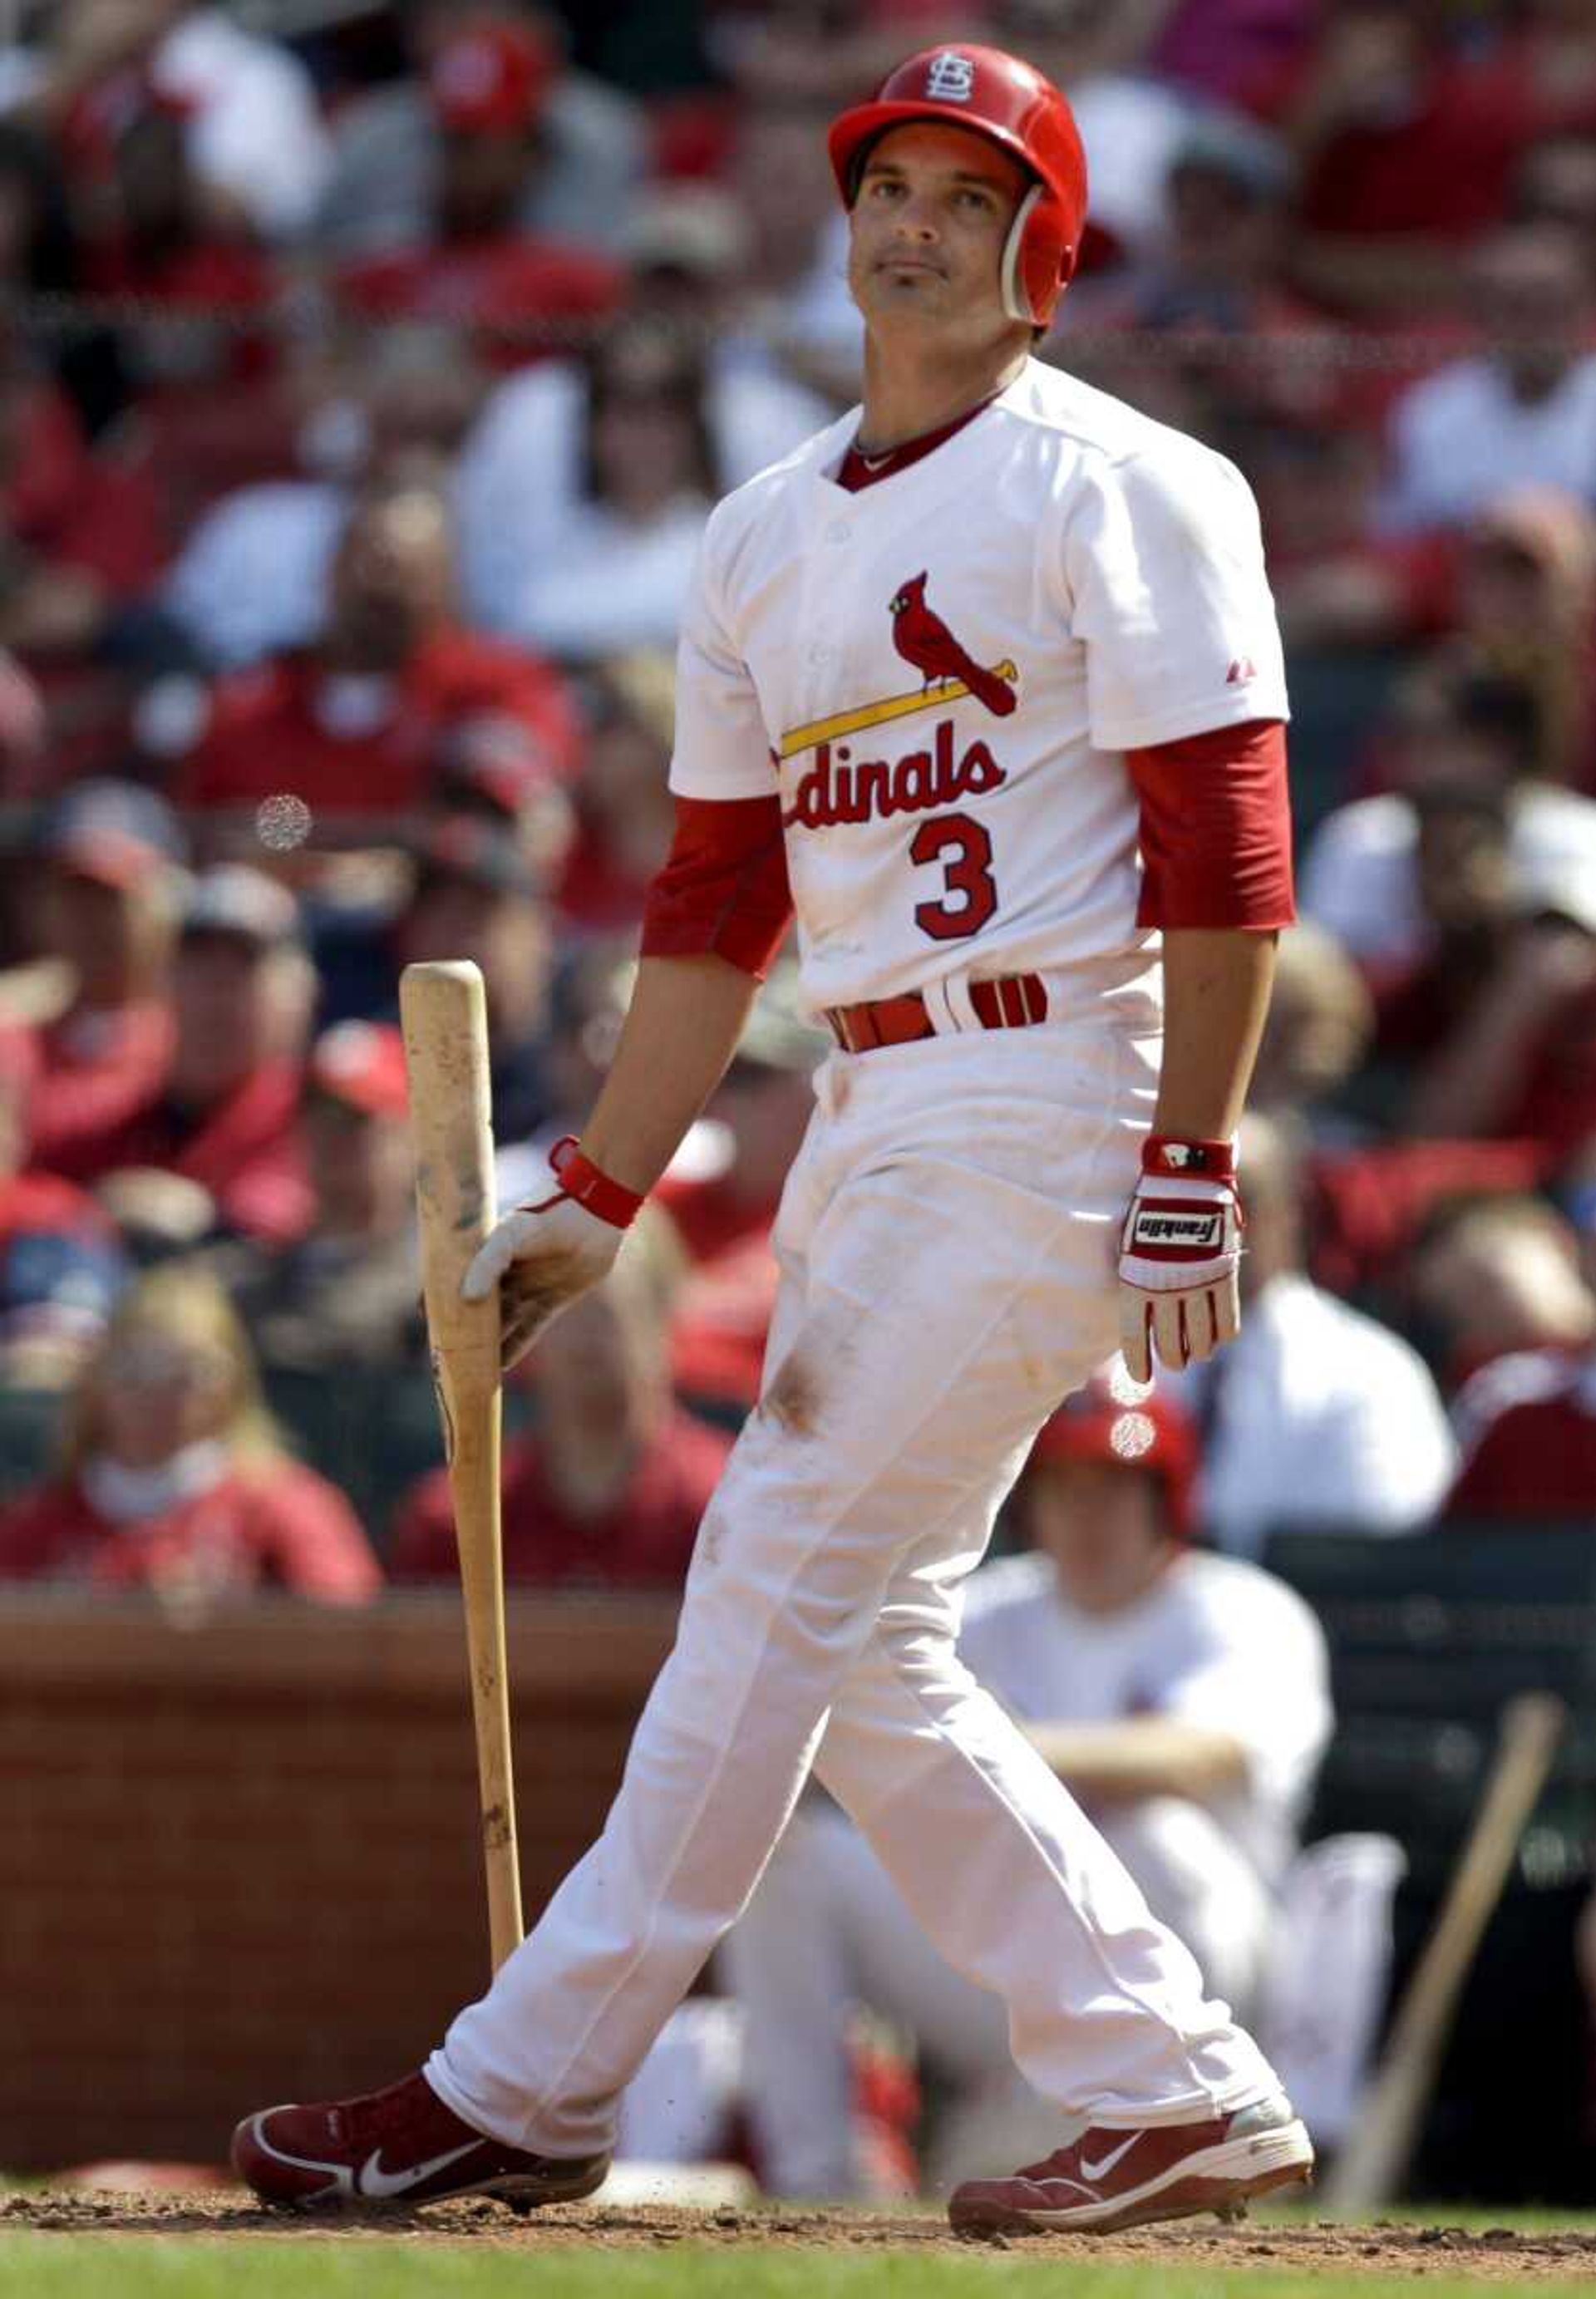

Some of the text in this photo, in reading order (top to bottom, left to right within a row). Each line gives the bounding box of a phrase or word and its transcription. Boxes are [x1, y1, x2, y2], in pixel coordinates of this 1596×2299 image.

[781, 720, 1007, 830] dinals
[910, 813, 998, 940] 3
[1138, 1217, 1217, 1243] Franklin
